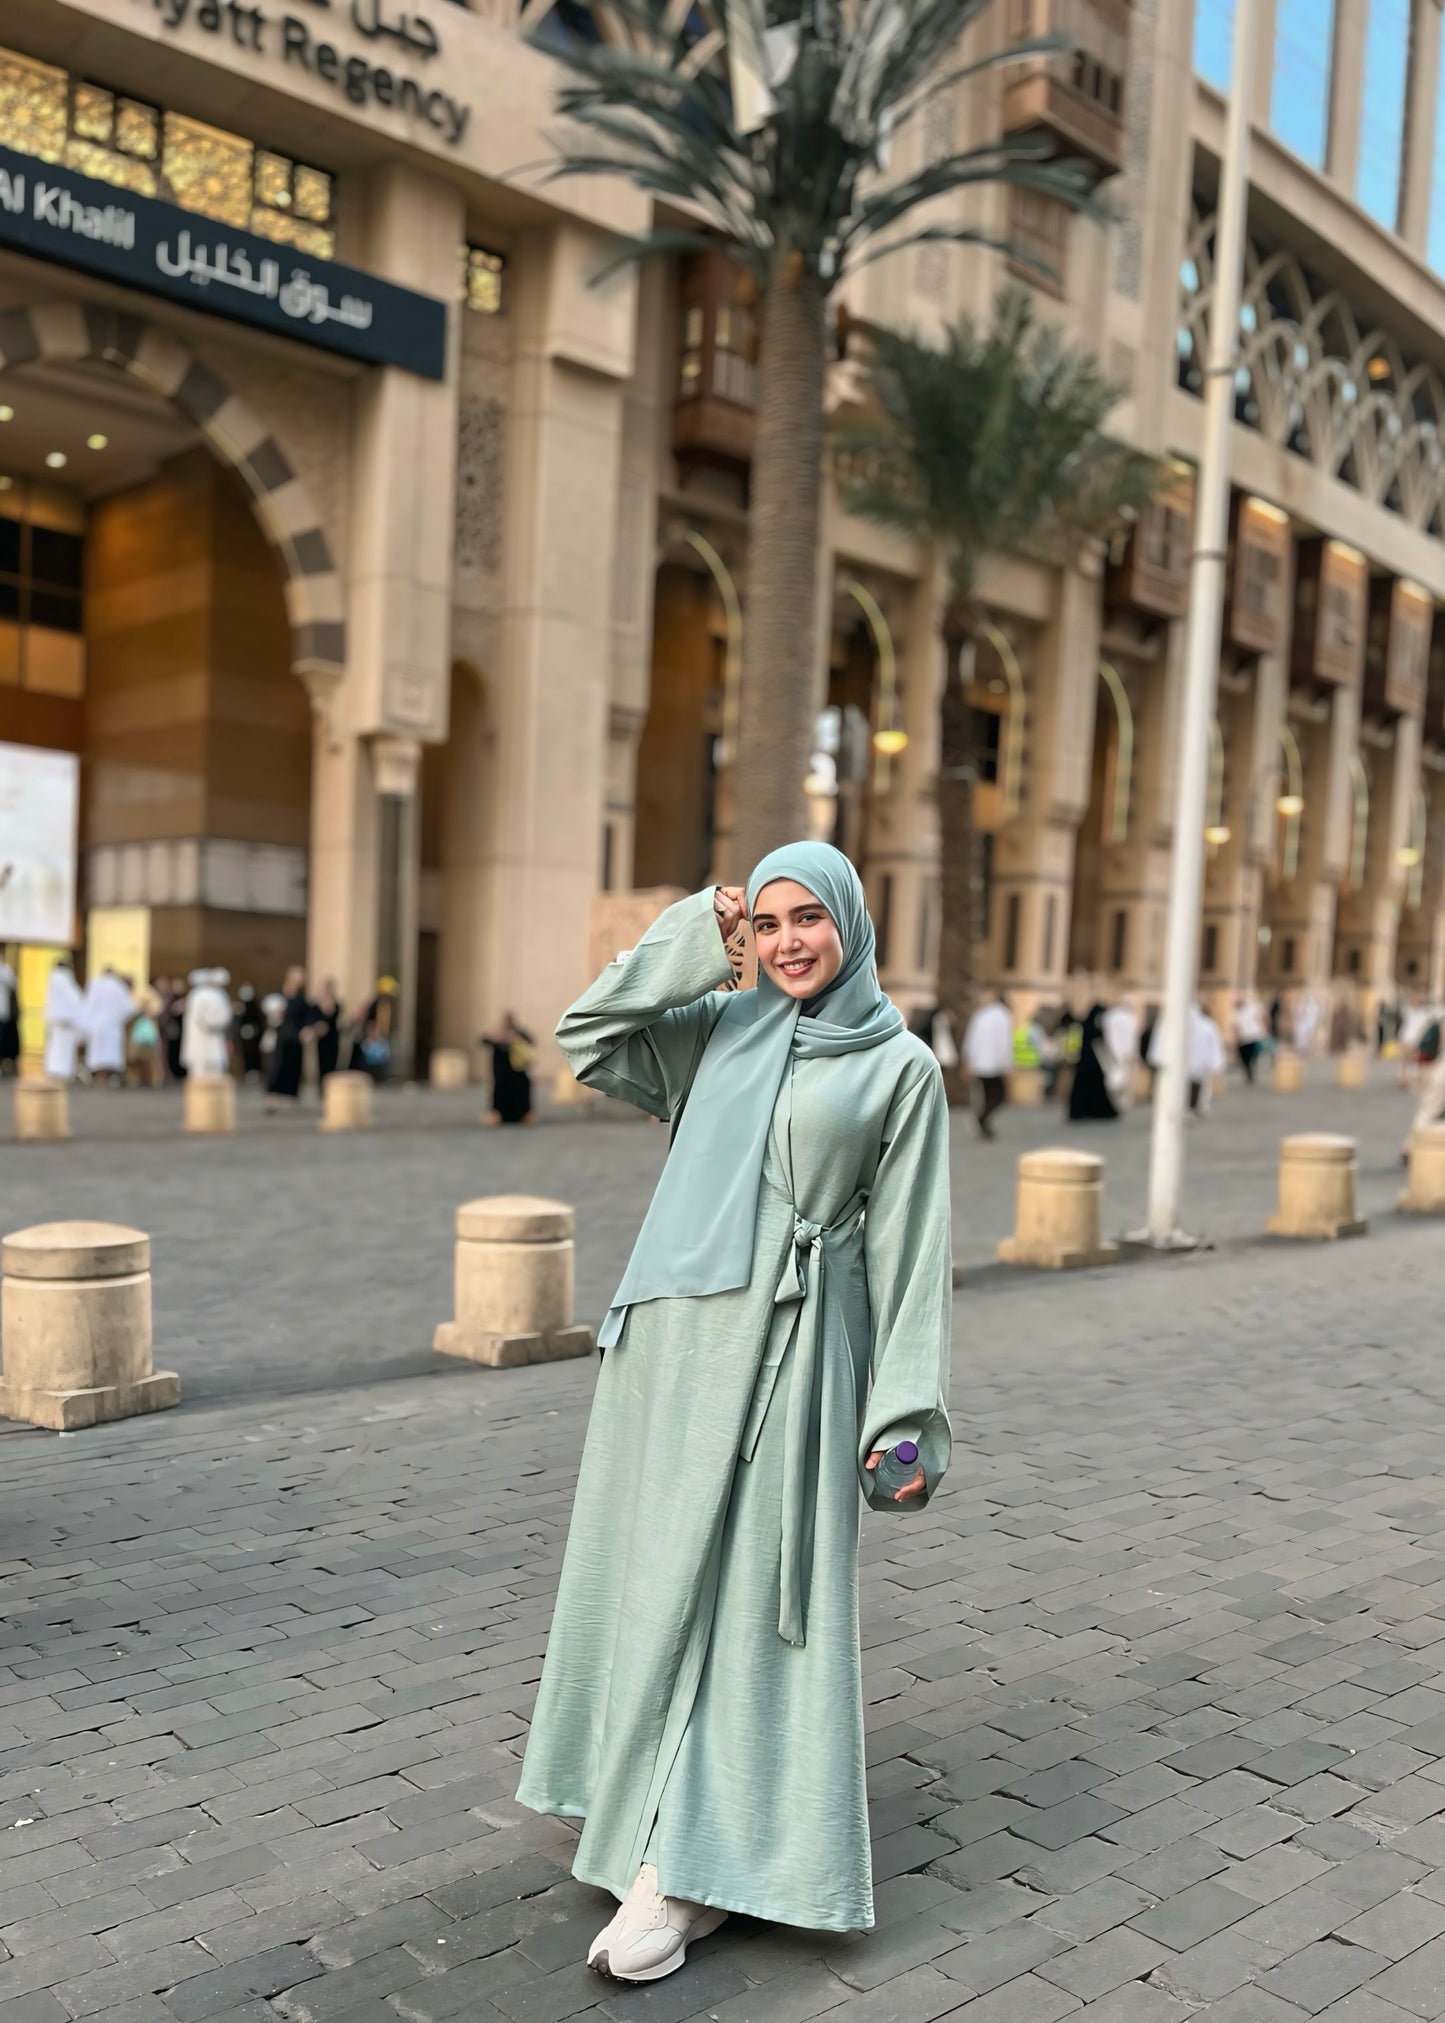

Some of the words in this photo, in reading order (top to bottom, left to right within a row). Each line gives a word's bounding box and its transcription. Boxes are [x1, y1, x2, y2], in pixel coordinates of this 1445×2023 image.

[153, 0, 264, 53] yatt
[283, 16, 470, 145] Regency
[33, 180, 135, 250] Khalil
[155, 229, 279, 299] الخليل
[279, 268, 373, 329] سوق
